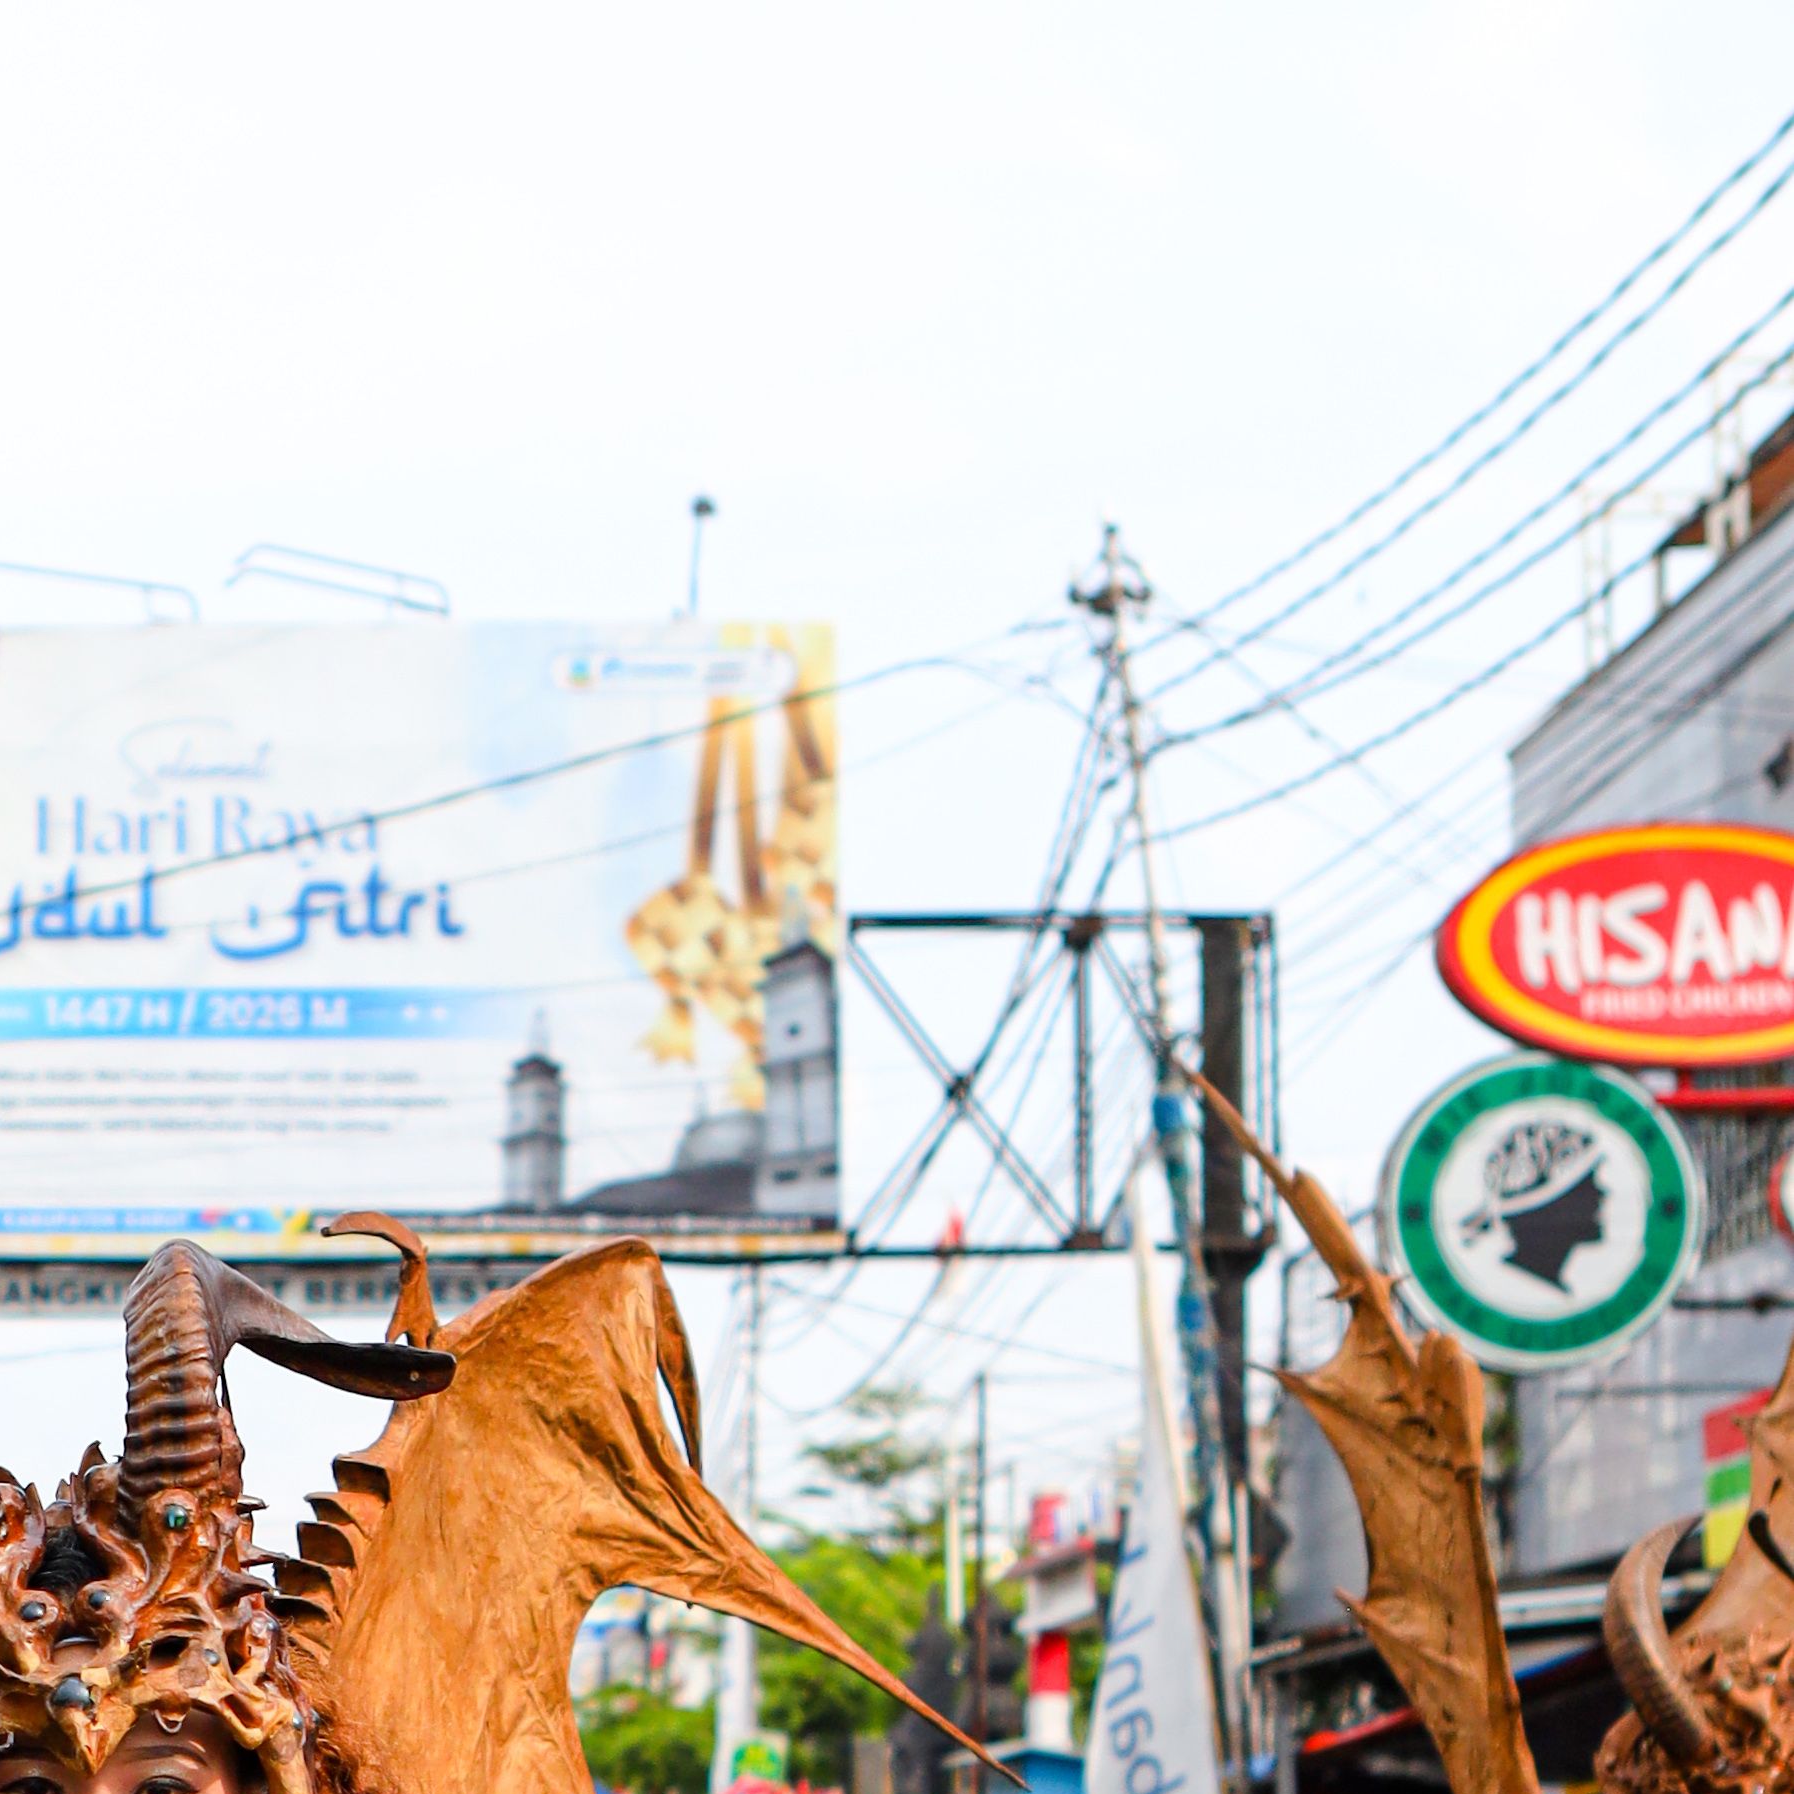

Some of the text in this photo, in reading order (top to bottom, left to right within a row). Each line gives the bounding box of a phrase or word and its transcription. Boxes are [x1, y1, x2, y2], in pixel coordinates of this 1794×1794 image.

[36, 796, 378, 869] Hari Raya
[209, 864, 465, 960] Fitri
[1515, 878, 1794, 995] HISAN
[46, 995, 131, 1029] 1447
[141, 999, 169, 1028] H
[310, 998, 348, 1028] M
